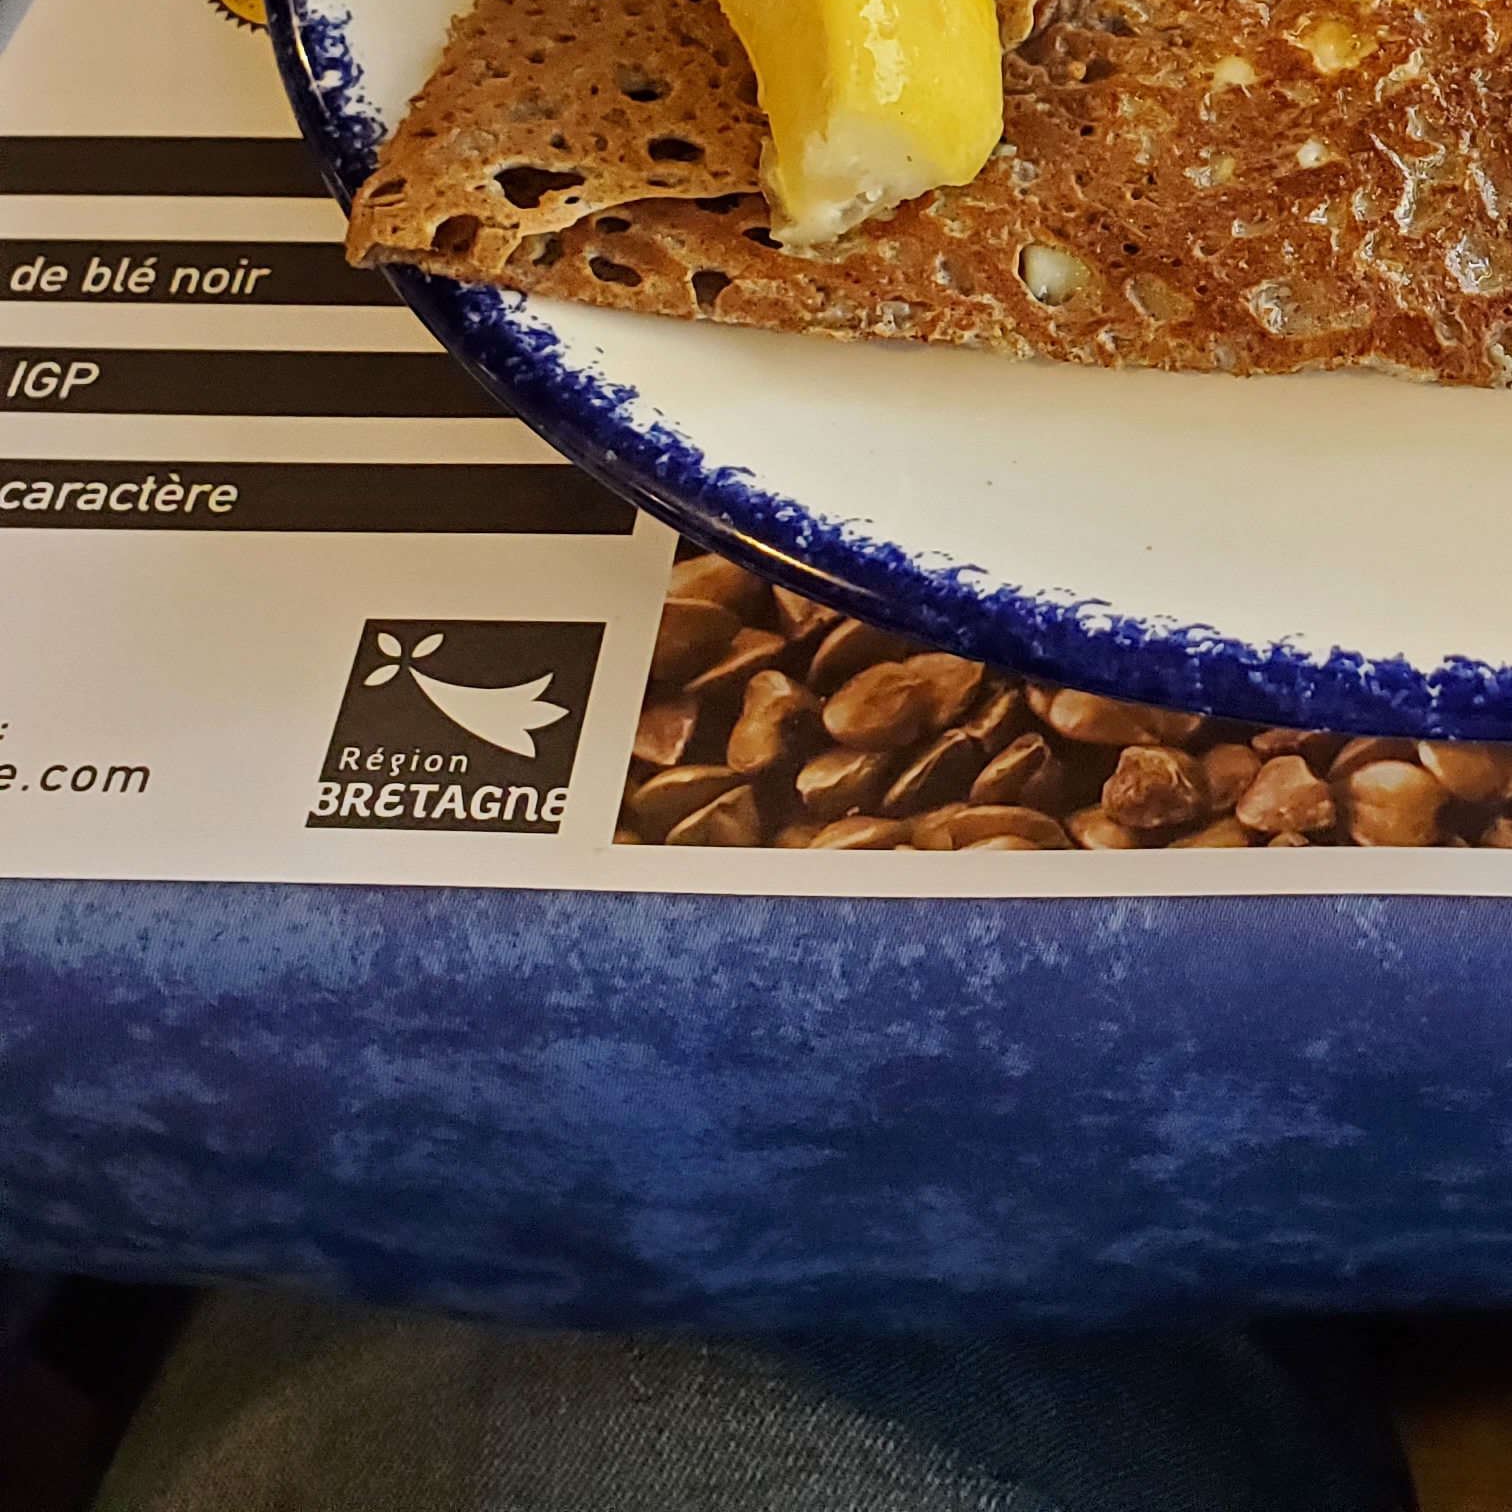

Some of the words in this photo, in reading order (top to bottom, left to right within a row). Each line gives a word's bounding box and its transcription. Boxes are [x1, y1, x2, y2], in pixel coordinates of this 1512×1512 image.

[9, 255, 69, 293] de
[81, 256, 158, 293] blé
[169, 258, 272, 295] noir
[6, 360, 100, 400] IGP
[0, 473, 239, 513] caractère
[338, 746, 469, 777] Région
